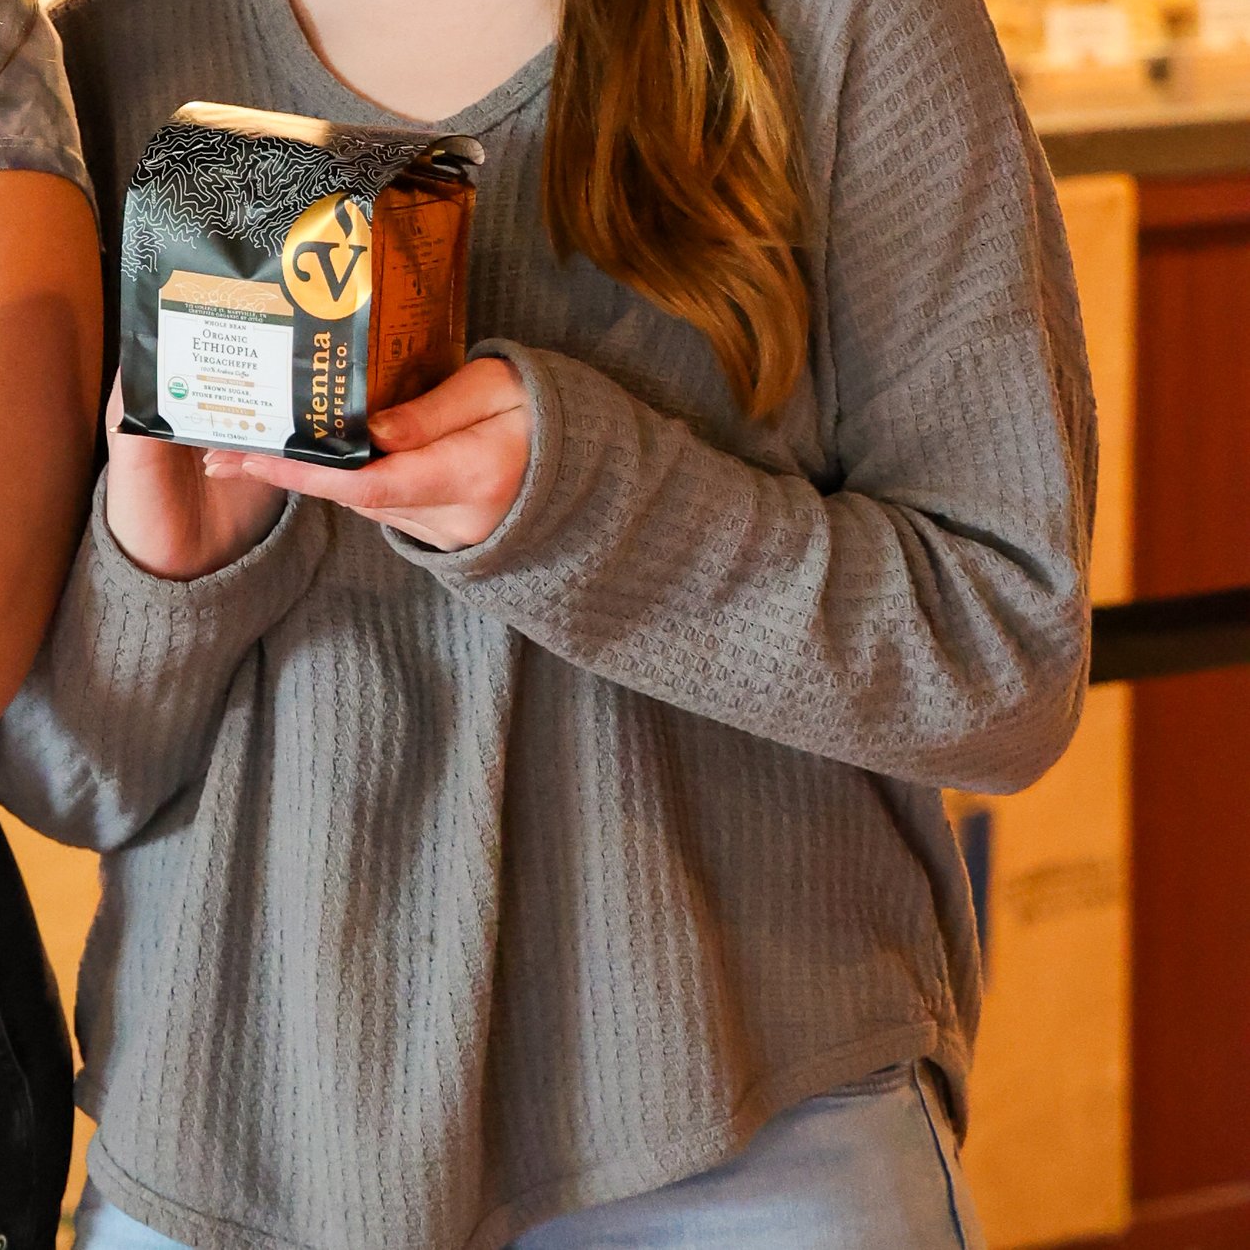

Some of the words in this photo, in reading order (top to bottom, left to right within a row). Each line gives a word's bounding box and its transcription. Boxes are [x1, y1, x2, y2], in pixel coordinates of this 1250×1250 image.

[204, 319, 227, 328] WHOLE
[202, 328, 248, 343] ORGANIC
[193, 337, 258, 358] ETHIOPIA
[336, 342, 348, 368] CO.
[193, 352, 258, 370] YIRGACHEFFE
[204, 384, 227, 392] BROWN
[305, 331, 331, 440] vienna
[192, 391, 212, 399] STONE
[238, 397, 258, 405] BLACK
[334, 375, 346, 439] COFFEE
